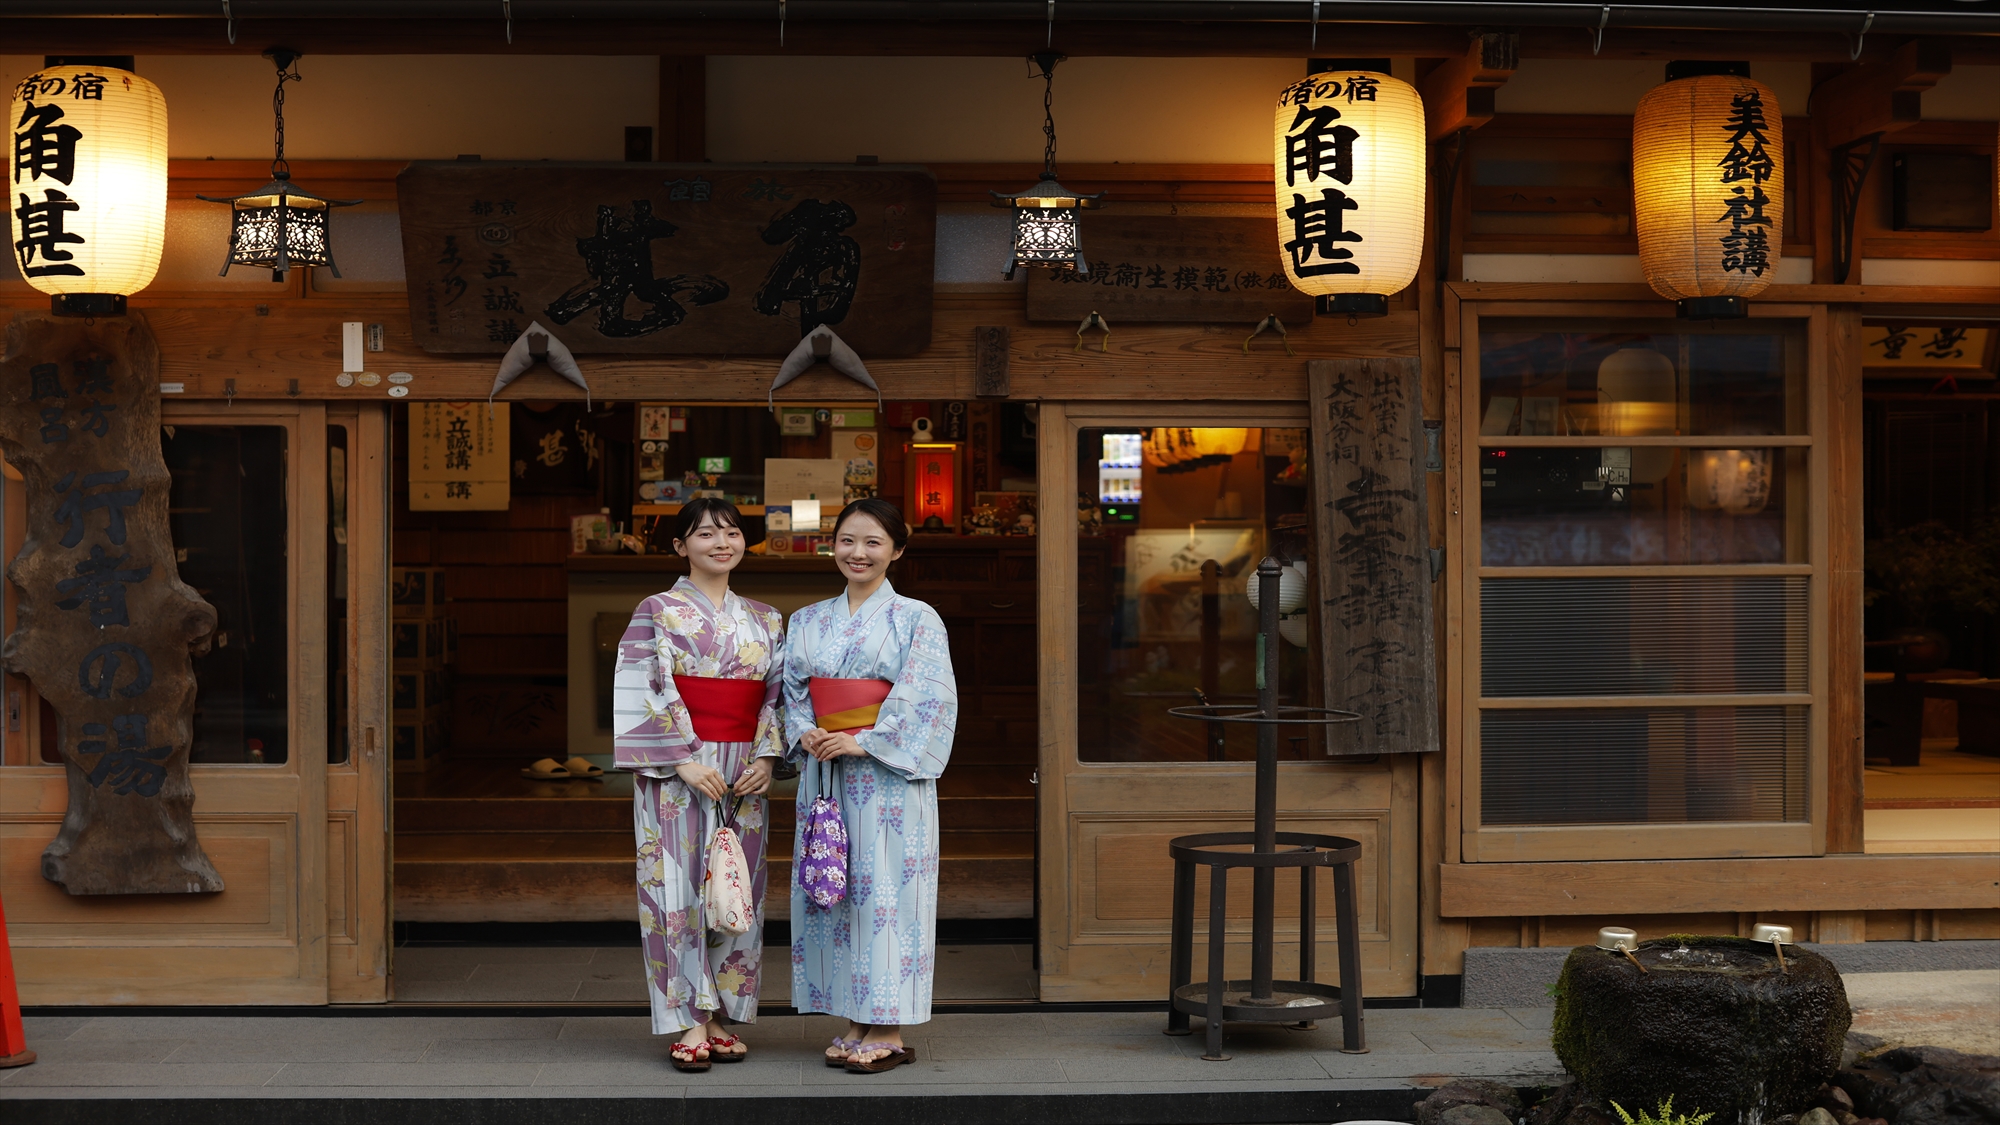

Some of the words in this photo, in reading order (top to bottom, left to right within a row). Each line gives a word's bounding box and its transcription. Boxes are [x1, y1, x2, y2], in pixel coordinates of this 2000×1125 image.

[14, 101, 85, 278] 角甚
[1284, 104, 1363, 280] 角甚
[1716, 88, 1775, 278] 美鈴社講
[482, 252, 524, 345] 立誠講
[29, 362, 69, 445] 風呂
[74, 354, 115, 438] 漢方
[1325, 371, 1364, 466] 大阪分祠
[444, 416, 473, 471] 立誠講
[926, 461, 941, 506] 角甚
[54, 469, 173, 798] 行者の湯
